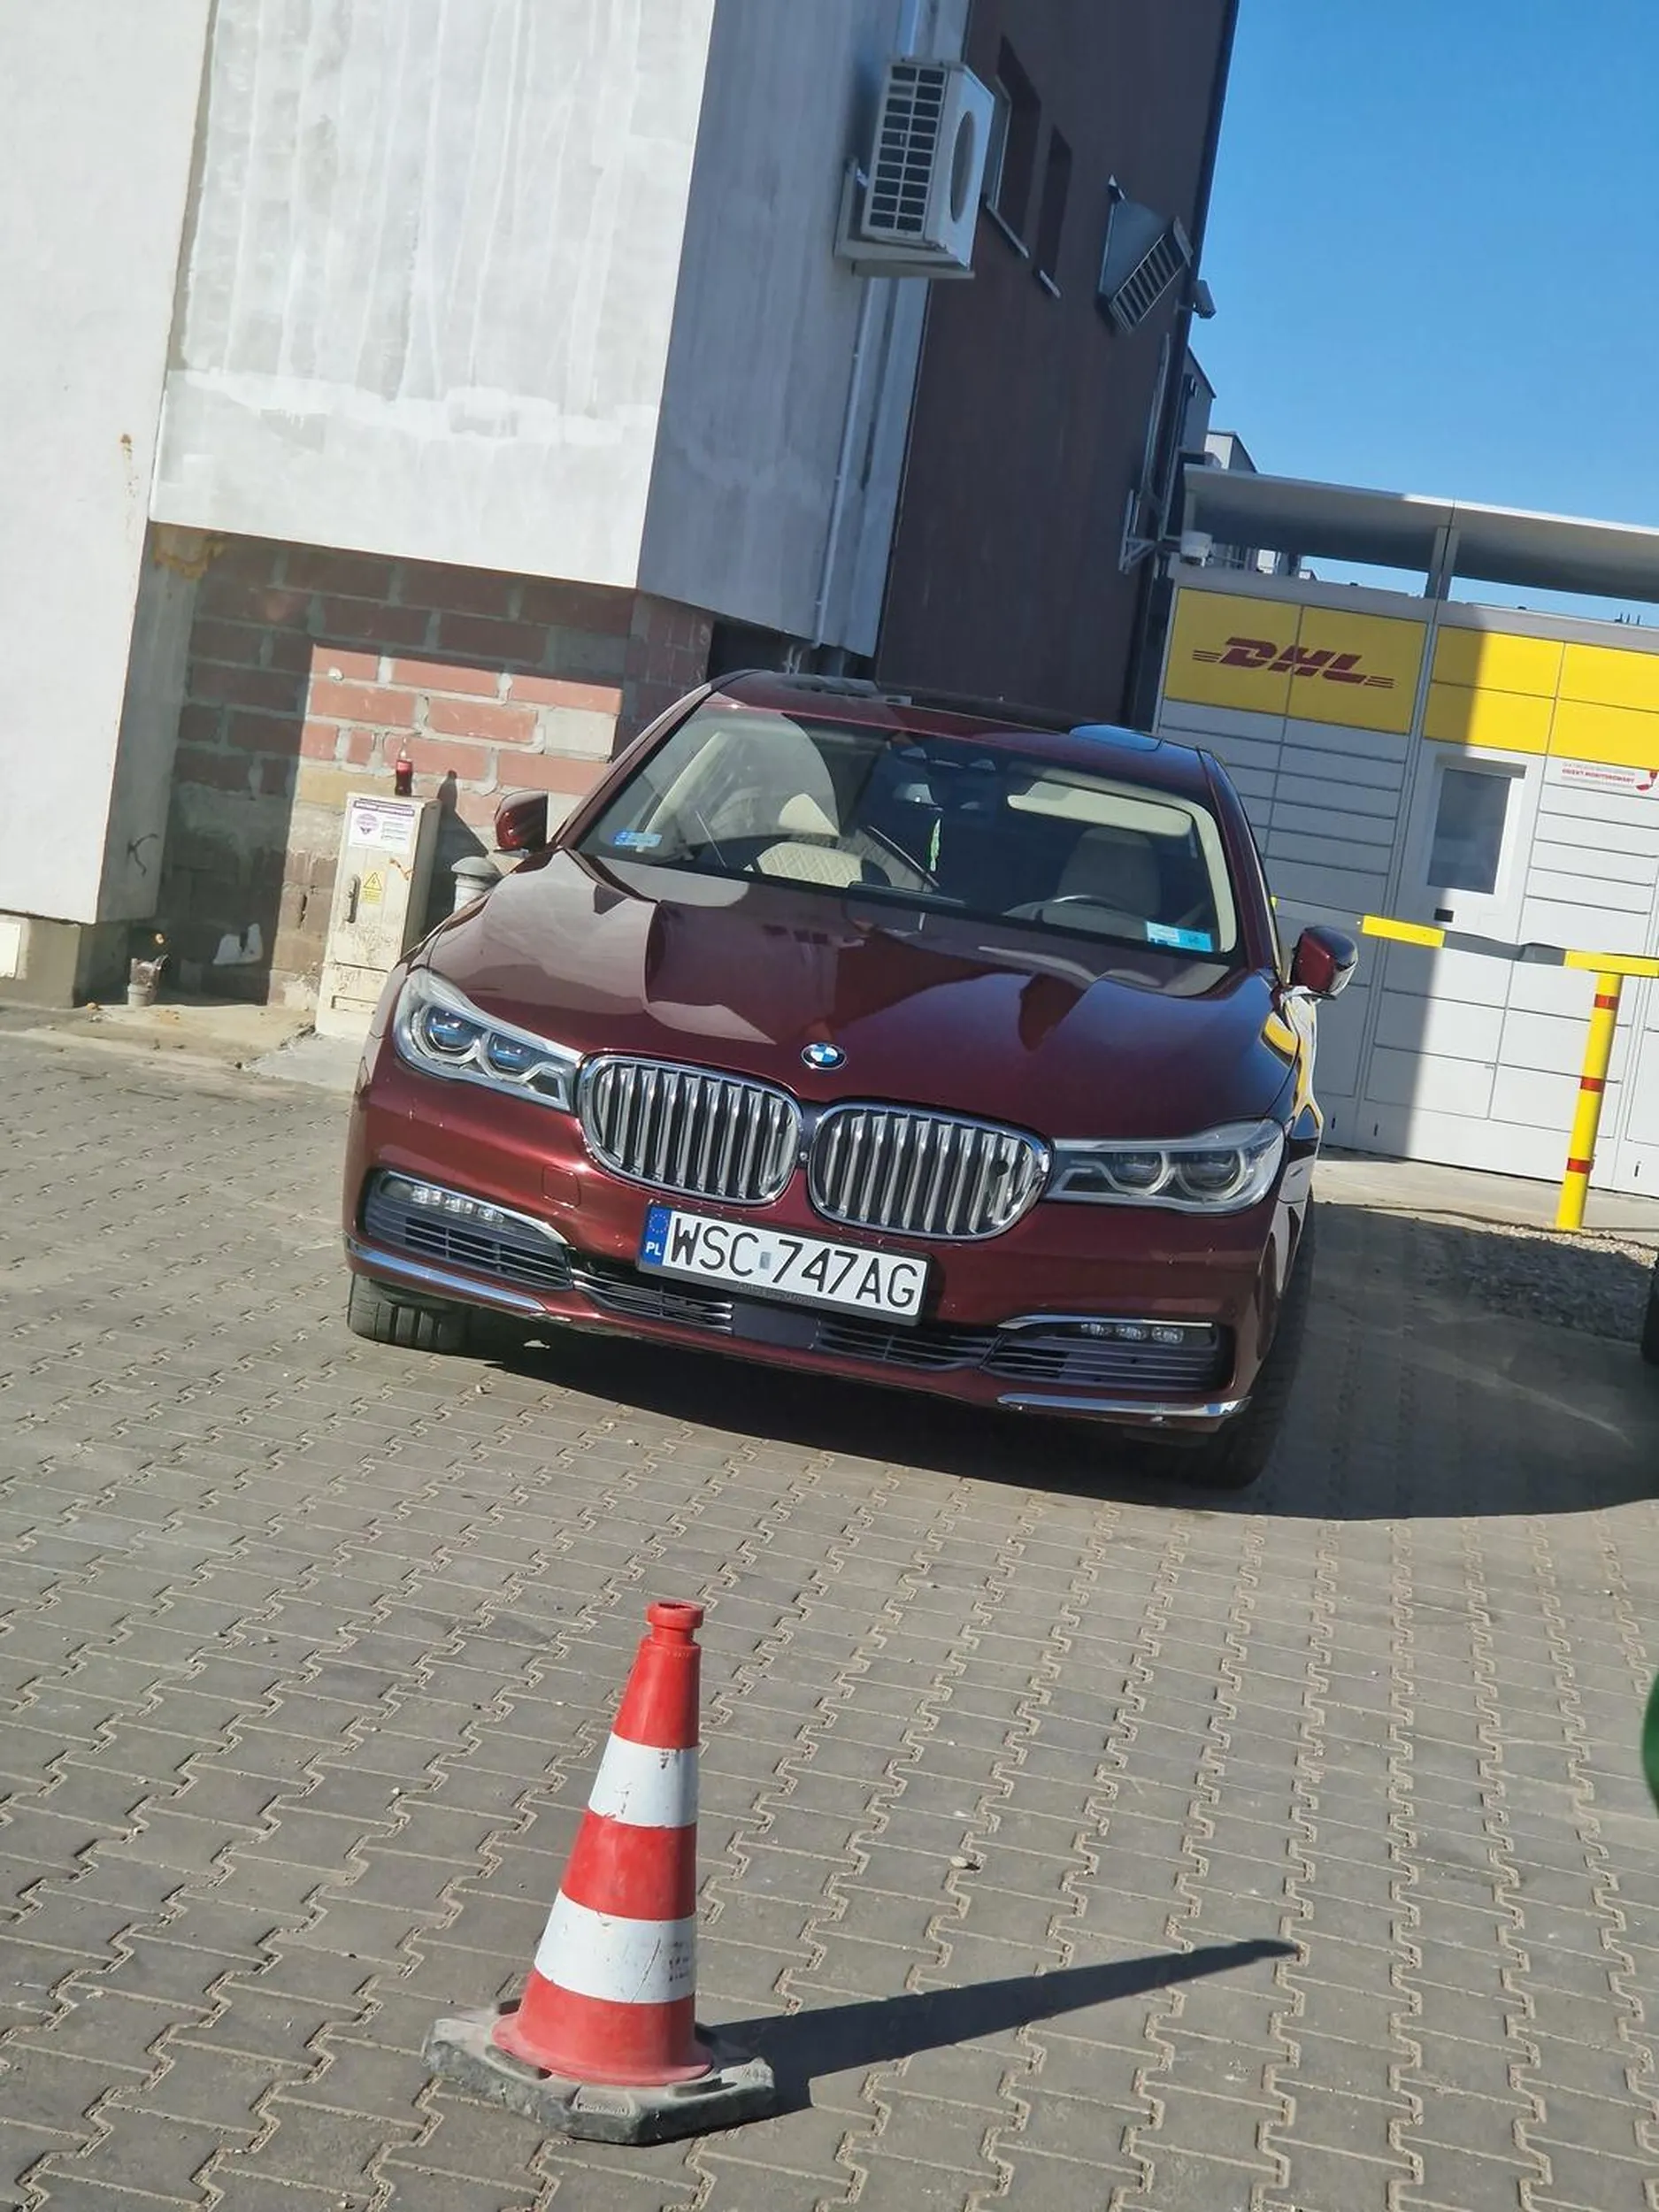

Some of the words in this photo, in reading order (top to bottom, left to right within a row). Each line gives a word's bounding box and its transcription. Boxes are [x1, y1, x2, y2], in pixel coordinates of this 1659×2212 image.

[1219, 637, 1367, 684] DHL
[646, 1241, 662, 1256] PL
[671, 1217, 760, 1278] WSC
[772, 1239, 918, 1308] 747AG
